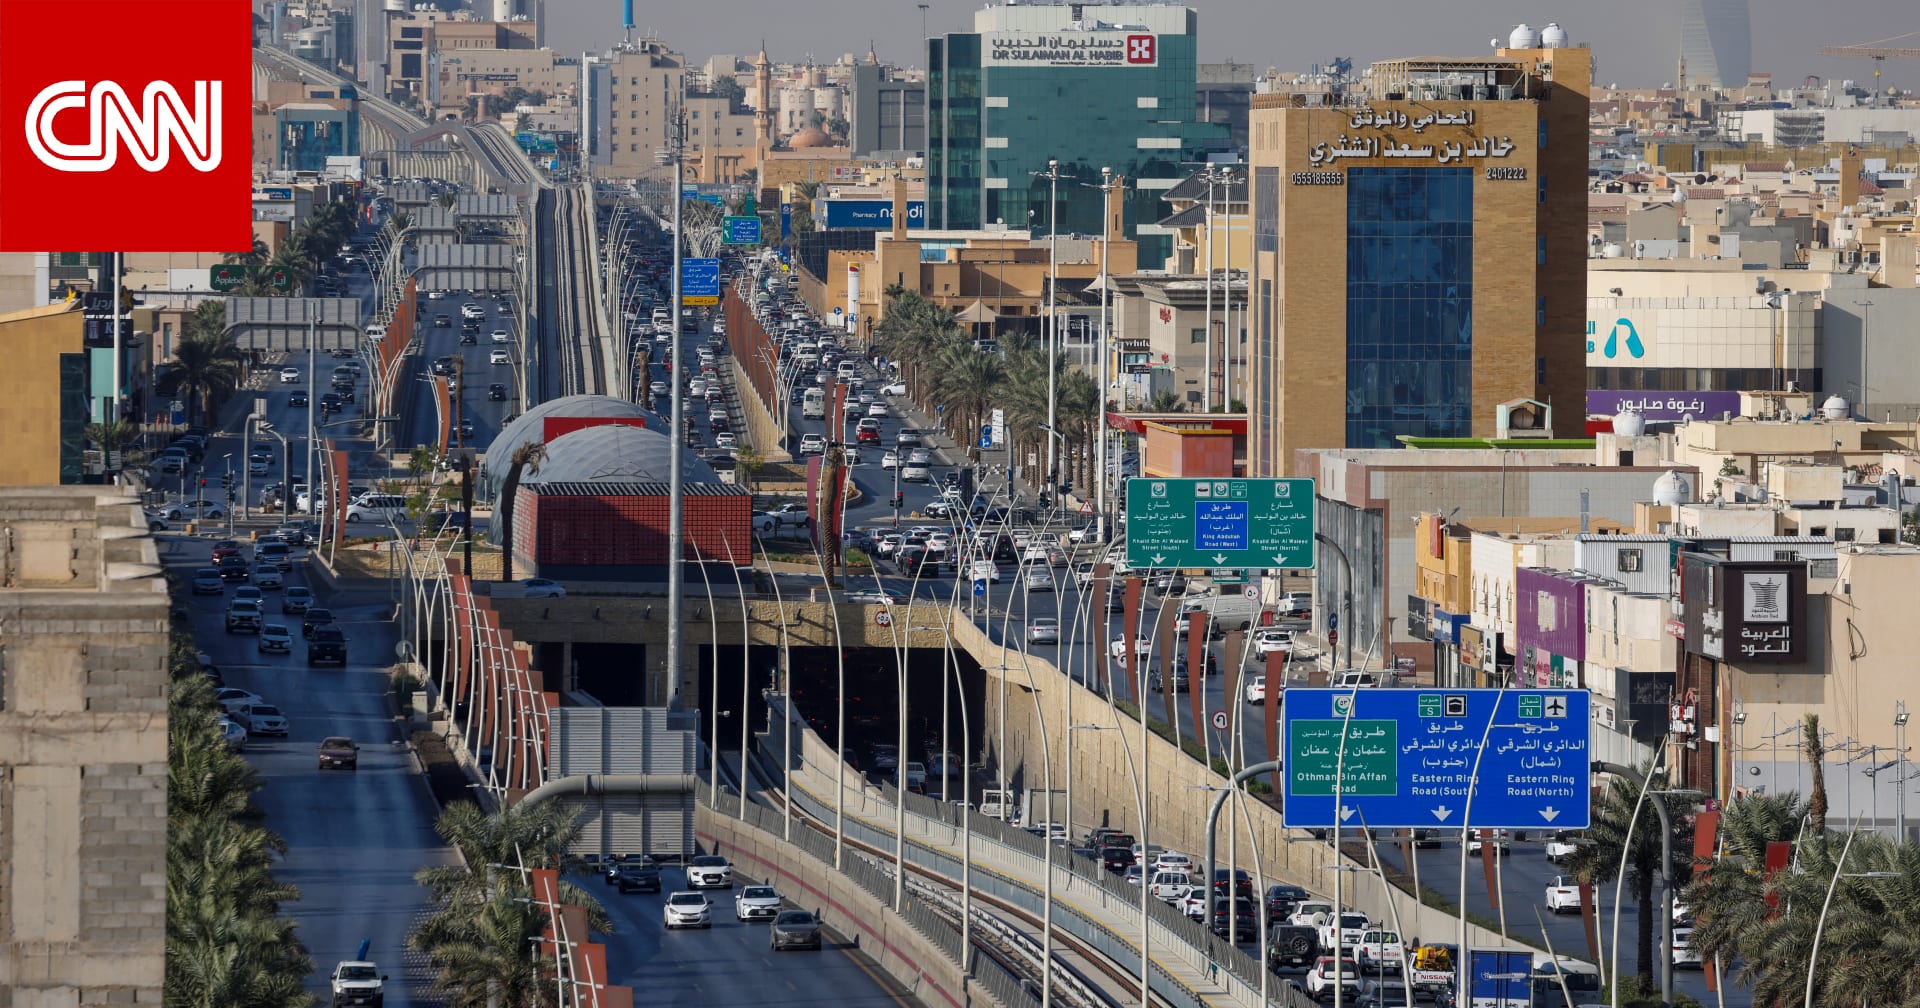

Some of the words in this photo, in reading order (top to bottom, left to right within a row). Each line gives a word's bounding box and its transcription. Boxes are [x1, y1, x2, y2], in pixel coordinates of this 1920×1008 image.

[992, 36, 1047, 49] الحبيب
[992, 50, 1010, 60] DR
[1011, 50, 1070, 60] SULAIMAN
[1072, 50, 1087, 60] AL
[1089, 50, 1124, 60] HABIB
[1349, 107, 1407, 129] والموثق
[1411, 108, 1474, 133] المحامي
[1309, 133, 1379, 168] الشثري
[1383, 137, 1433, 158] سعد
[1437, 138, 1462, 163] بن
[1466, 135, 1515, 158] خالد
[1291, 172, 1342, 185] 0555185555
[1486, 167, 1525, 181] 2401222
[104, 321, 126, 334] KC
[1616, 397, 1664, 414] صابون
[1667, 397, 1705, 414] رغوة
[1147, 501, 1171, 511] شارع
[1211, 503, 1232, 512] طريق
[1270, 501, 1294, 511] شارع
[1133, 512, 1159, 521] الوليد
[1159, 513, 1169, 521] بن
[1170, 512, 1187, 520] خالد
[1253, 512, 1279, 521] الوليد
[1280, 513, 1289, 521] بن
[1290, 512, 1307, 520] خالد
[1741, 626, 1790, 641] العربية
[1741, 640, 1790, 656] للعود
[1521, 697, 1539, 705] شمال
[1427, 707, 1434, 716] S
[1526, 708, 1533, 716] N
[1348, 726, 1386, 739] طريق
[1427, 721, 1464, 734] طريق
[1522, 722, 1560, 734] طريق
[1301, 744, 1330, 757] عفان
[1352, 744, 1387, 757] عثمان
[1402, 738, 1445, 753] الشرقي
[1497, 739, 1540, 754] الشرقي
[1543, 740, 1585, 753] الدائري
[1422, 756, 1469, 768] (جنوب)
[1521, 756, 1561, 768] (شمال)
[1297, 772, 1336, 781] Othman
[1359, 772, 1387, 781] Affan
[1412, 774, 1453, 783] Eastern
[1508, 775, 1549, 783] Eastern
[1551, 775, 1575, 785] Ring
[1412, 787, 1437, 796] Road
[1439, 787, 1478, 796] (Sout)
[1508, 788, 1532, 796] Road
[1534, 788, 1574, 797] (North)
